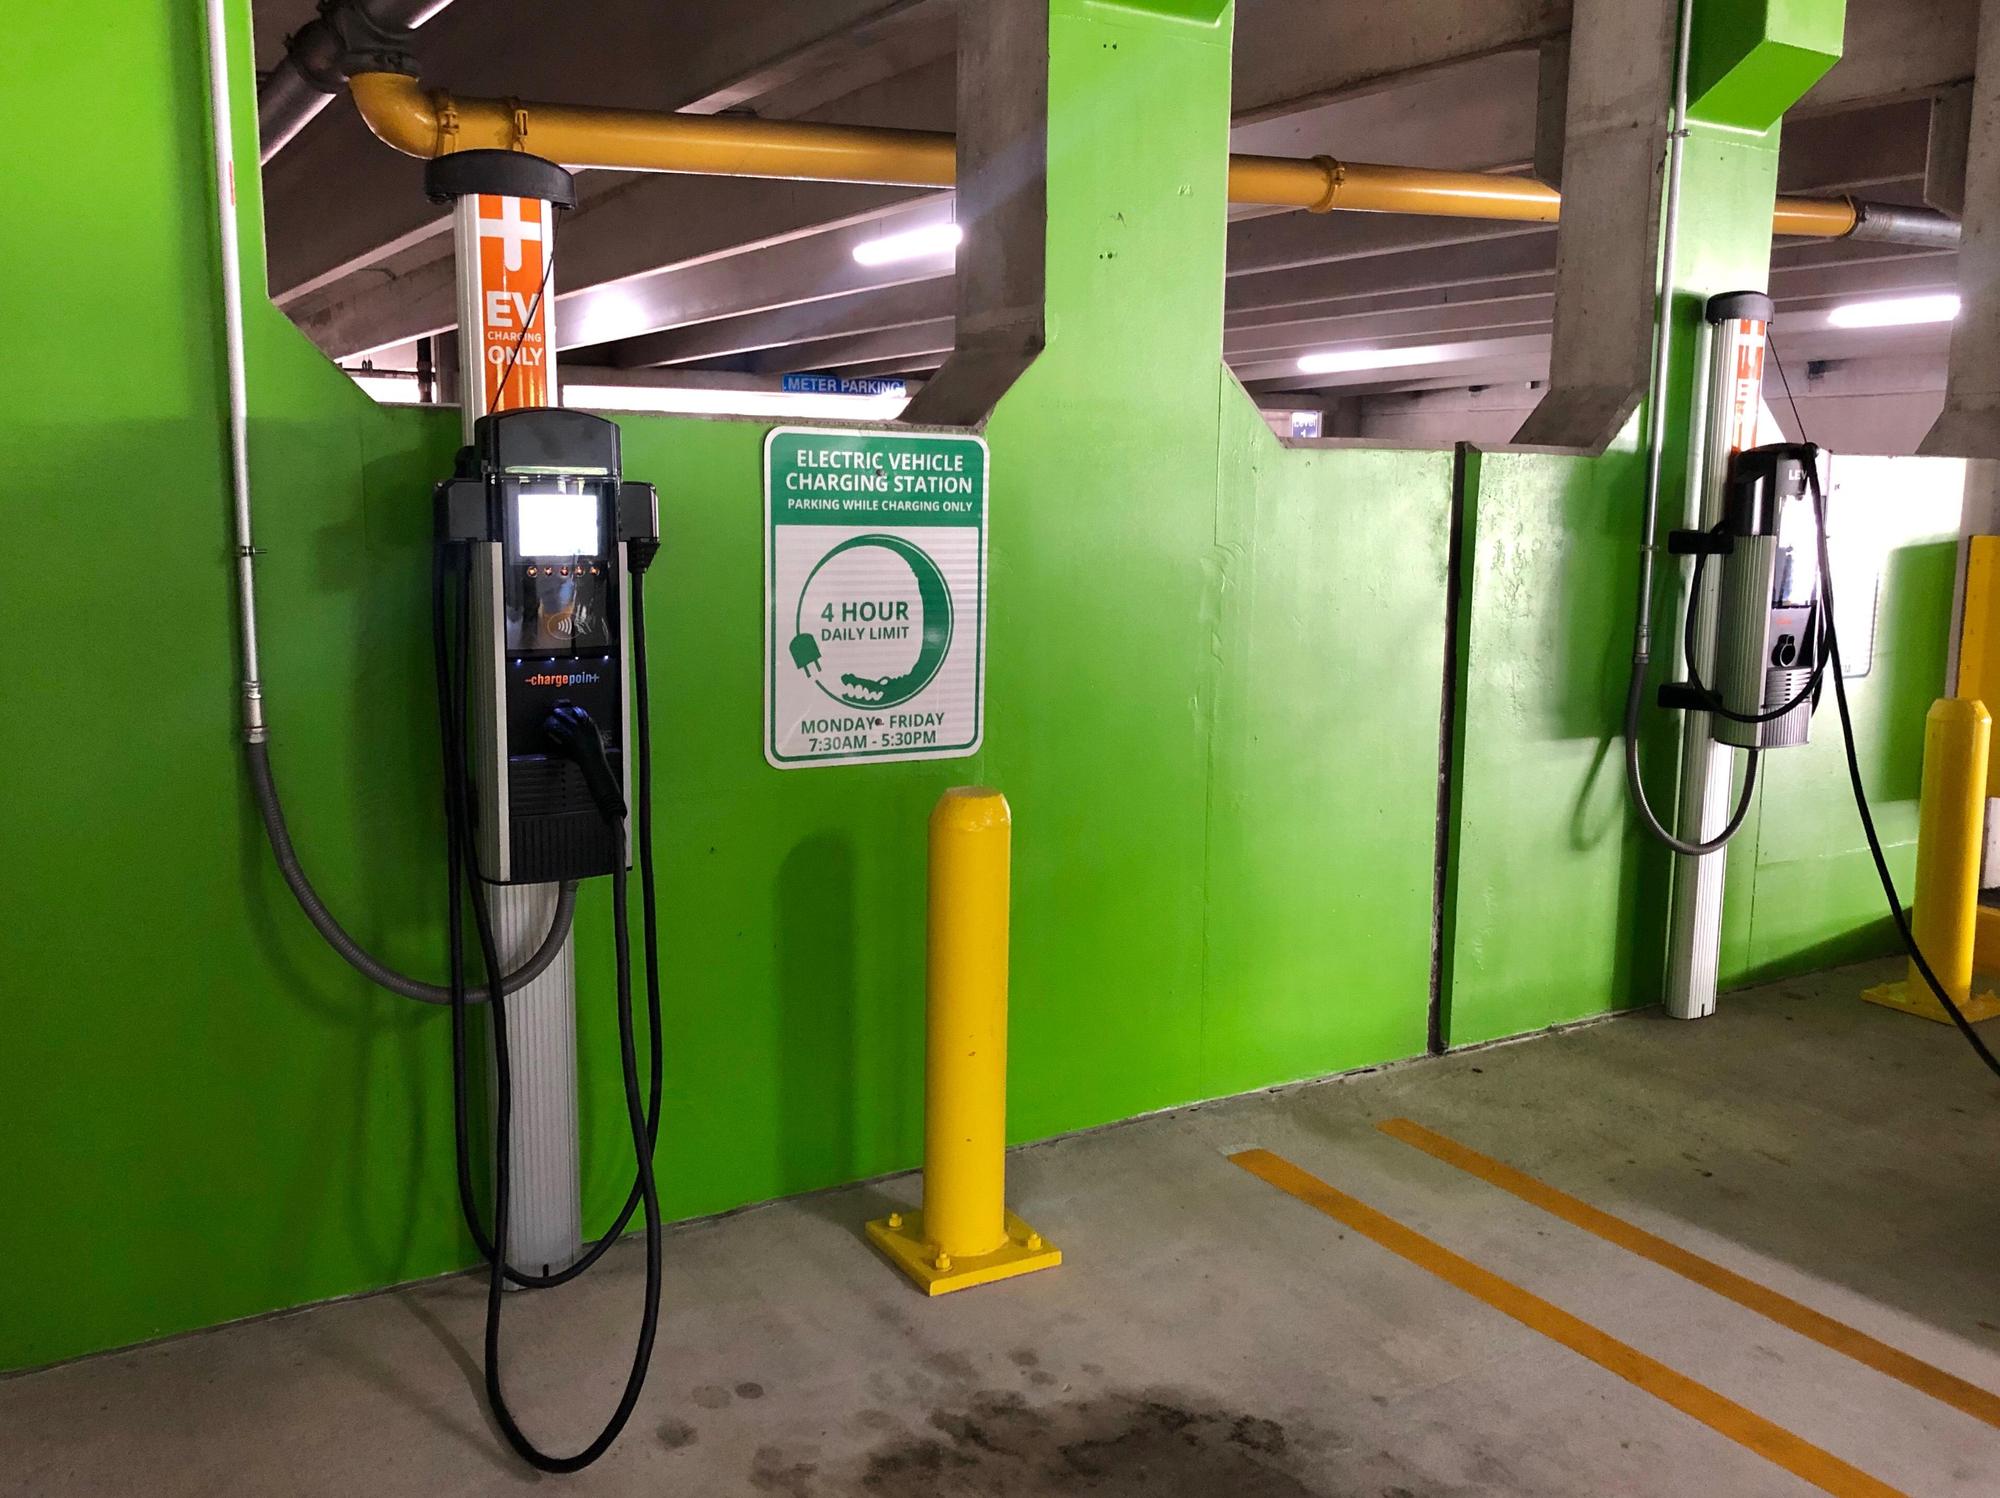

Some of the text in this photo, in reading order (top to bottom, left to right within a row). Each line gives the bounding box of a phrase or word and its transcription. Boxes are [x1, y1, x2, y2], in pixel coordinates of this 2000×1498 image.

[487, 290, 540, 329] EV
[487, 345, 543, 366] ONLY
[787, 377, 836, 391] METER
[797, 449, 963, 472] ELECTRIC VEHICLE
[785, 472, 972, 494] CHARGING STATION
[787, 498, 973, 512] PARKING WHILE CHARGING ONLY
[821, 601, 909, 622] 4 HOUR
[821, 626, 910, 642] DAILY LIMIT
[800, 712, 945, 734] MONDAY FRIDAY
[809, 735, 867, 753] 7:30AM
[881, 730, 937, 747] 5:30PM
